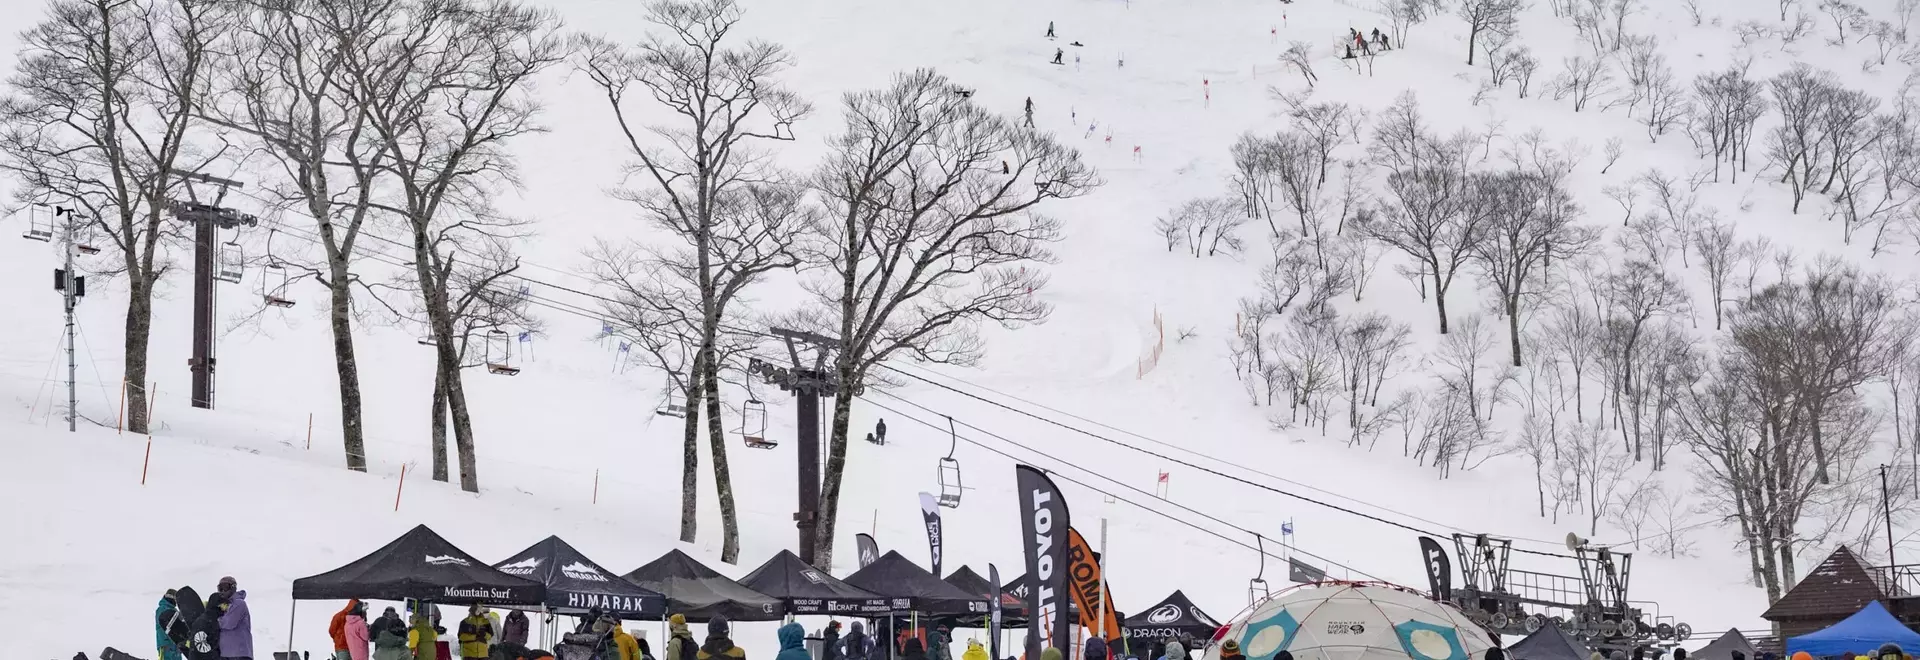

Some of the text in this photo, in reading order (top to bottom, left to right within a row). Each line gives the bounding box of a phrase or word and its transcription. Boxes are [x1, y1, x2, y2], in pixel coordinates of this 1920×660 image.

[563, 571, 608, 582] HIMARAK
[444, 587, 511, 599] Mountain Surf
[568, 592, 643, 612] HIMARAK
[1133, 628, 1181, 638] DRAGON
